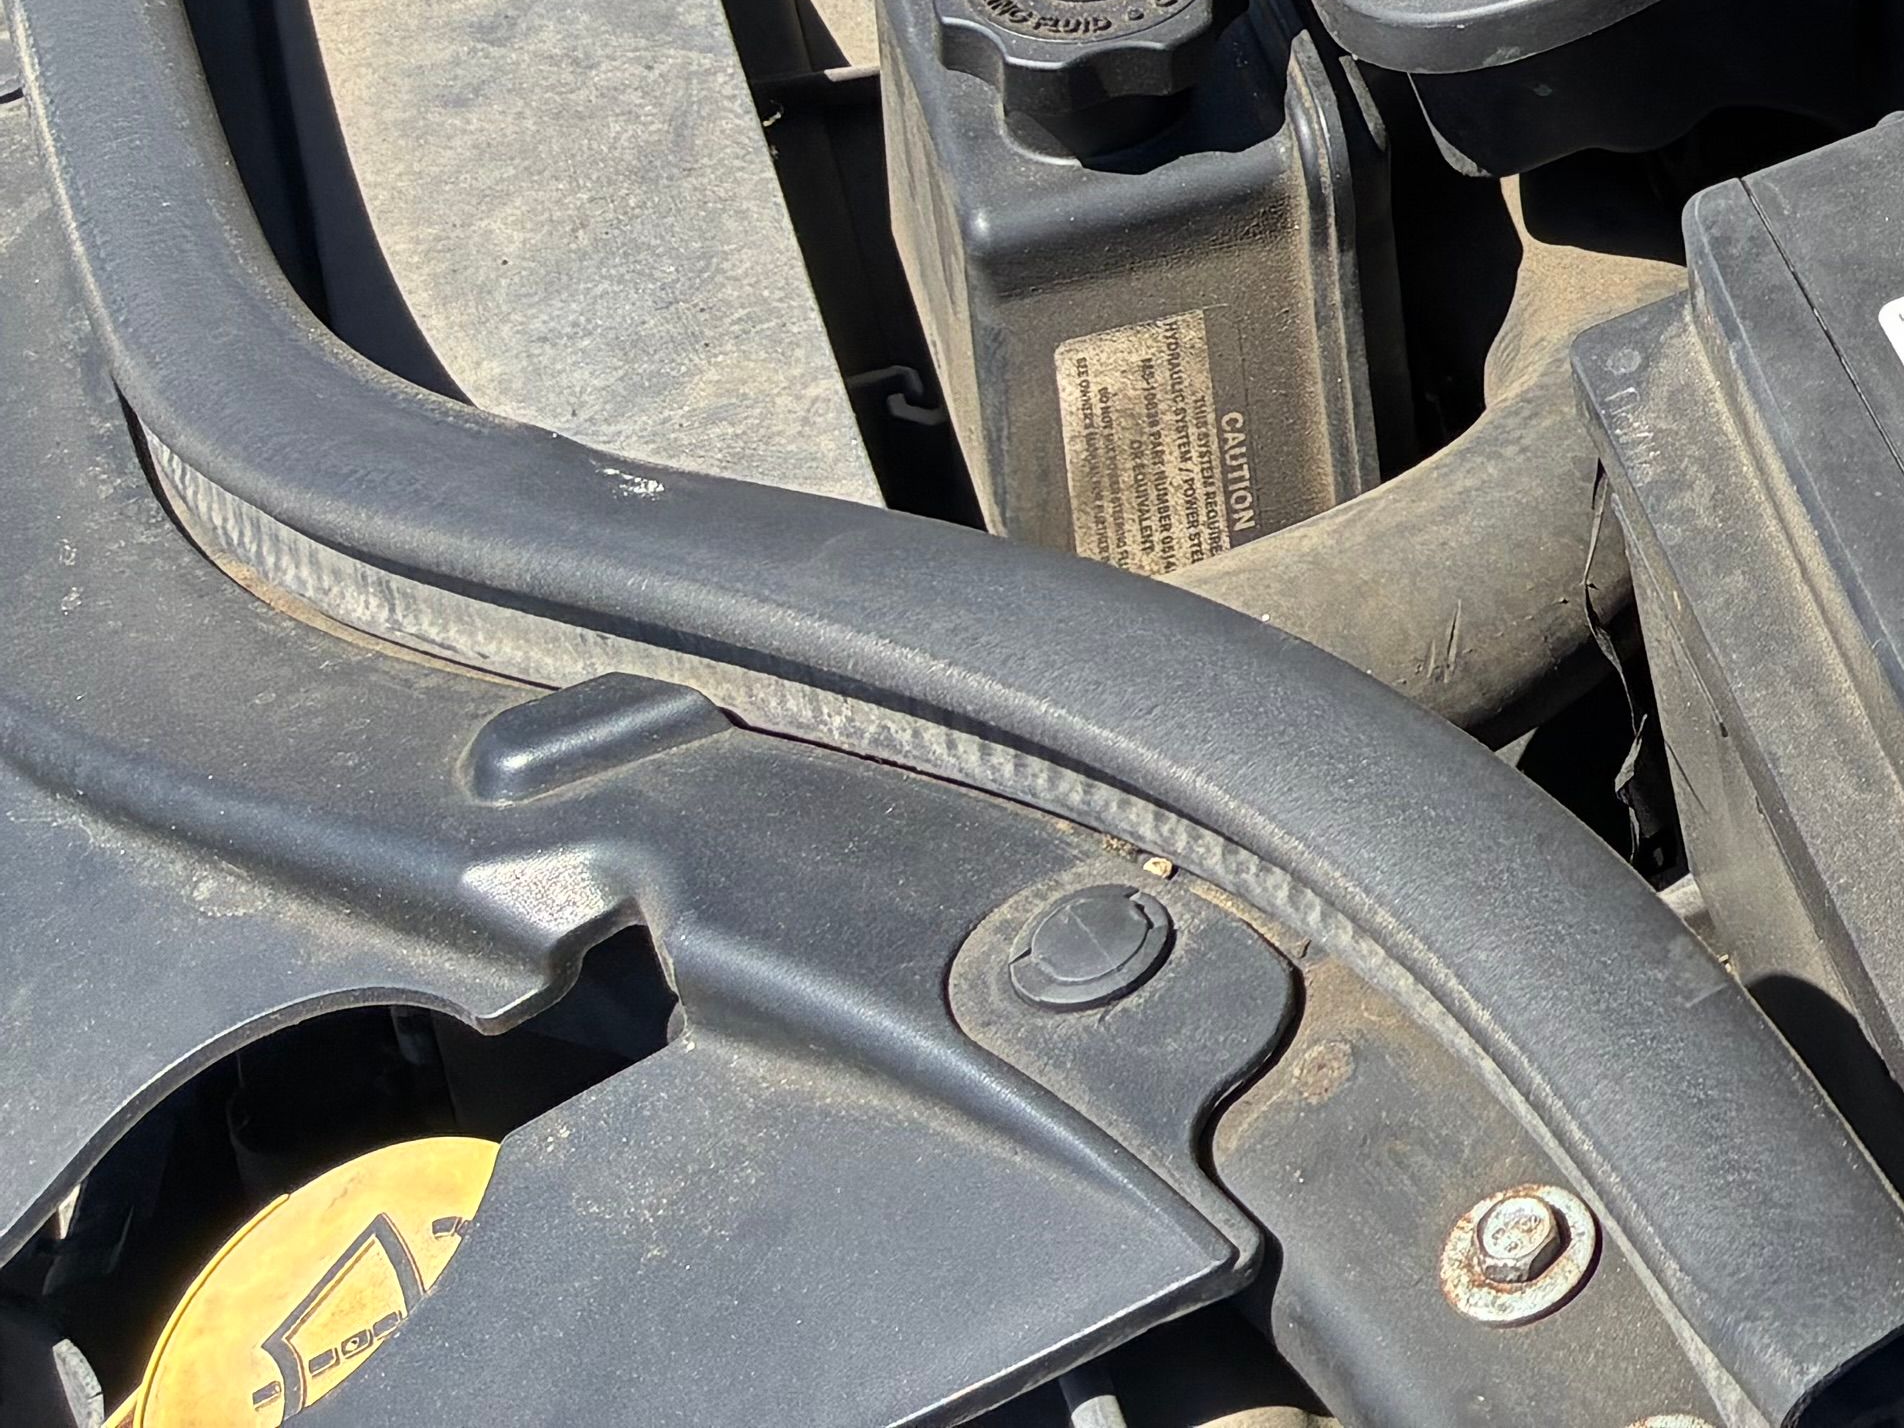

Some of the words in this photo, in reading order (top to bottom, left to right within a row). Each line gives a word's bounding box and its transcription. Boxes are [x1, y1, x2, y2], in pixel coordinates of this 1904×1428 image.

[1163, 320, 1185, 404] HYDRAULIC
[1172, 405, 1191, 468] SYSTEM
[1196, 431, 1214, 490] SYSTEM
[1151, 471, 1170, 533] NUMBER
[1180, 476, 1199, 531] POWER
[1219, 410, 1254, 532] CAUTION
[1133, 464, 1154, 554] EQUIVALENT
[1202, 490, 1221, 558] REQUIRE
